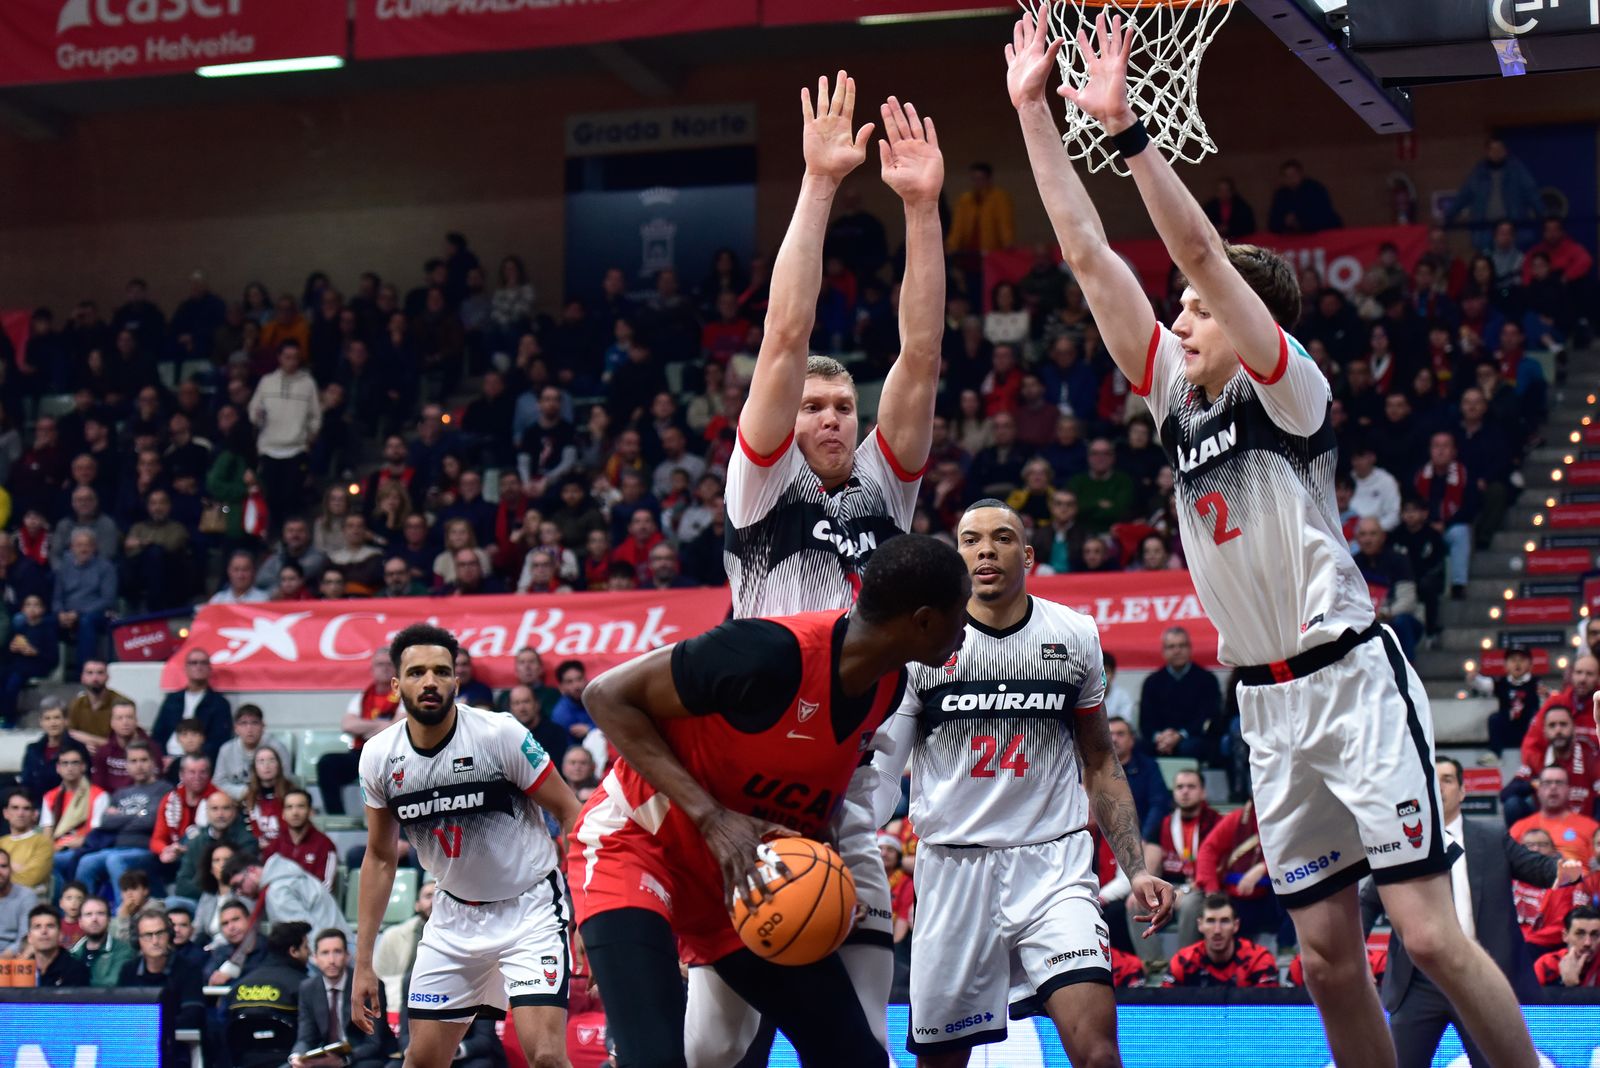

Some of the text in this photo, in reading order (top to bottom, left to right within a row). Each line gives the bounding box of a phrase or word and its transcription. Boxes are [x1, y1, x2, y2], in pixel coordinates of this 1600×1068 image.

[57, 31, 254, 71] Grupo Helvetia
[574, 114, 747, 146] Grada Norte
[1195, 491, 1242, 545] 2
[1095, 594, 1208, 625] LEVA
[970, 733, 1030, 778] 24
[1398, 804, 1416, 817] acb
[1051, 949, 1098, 965] BERNER
[915, 1027, 939, 1035] vive
